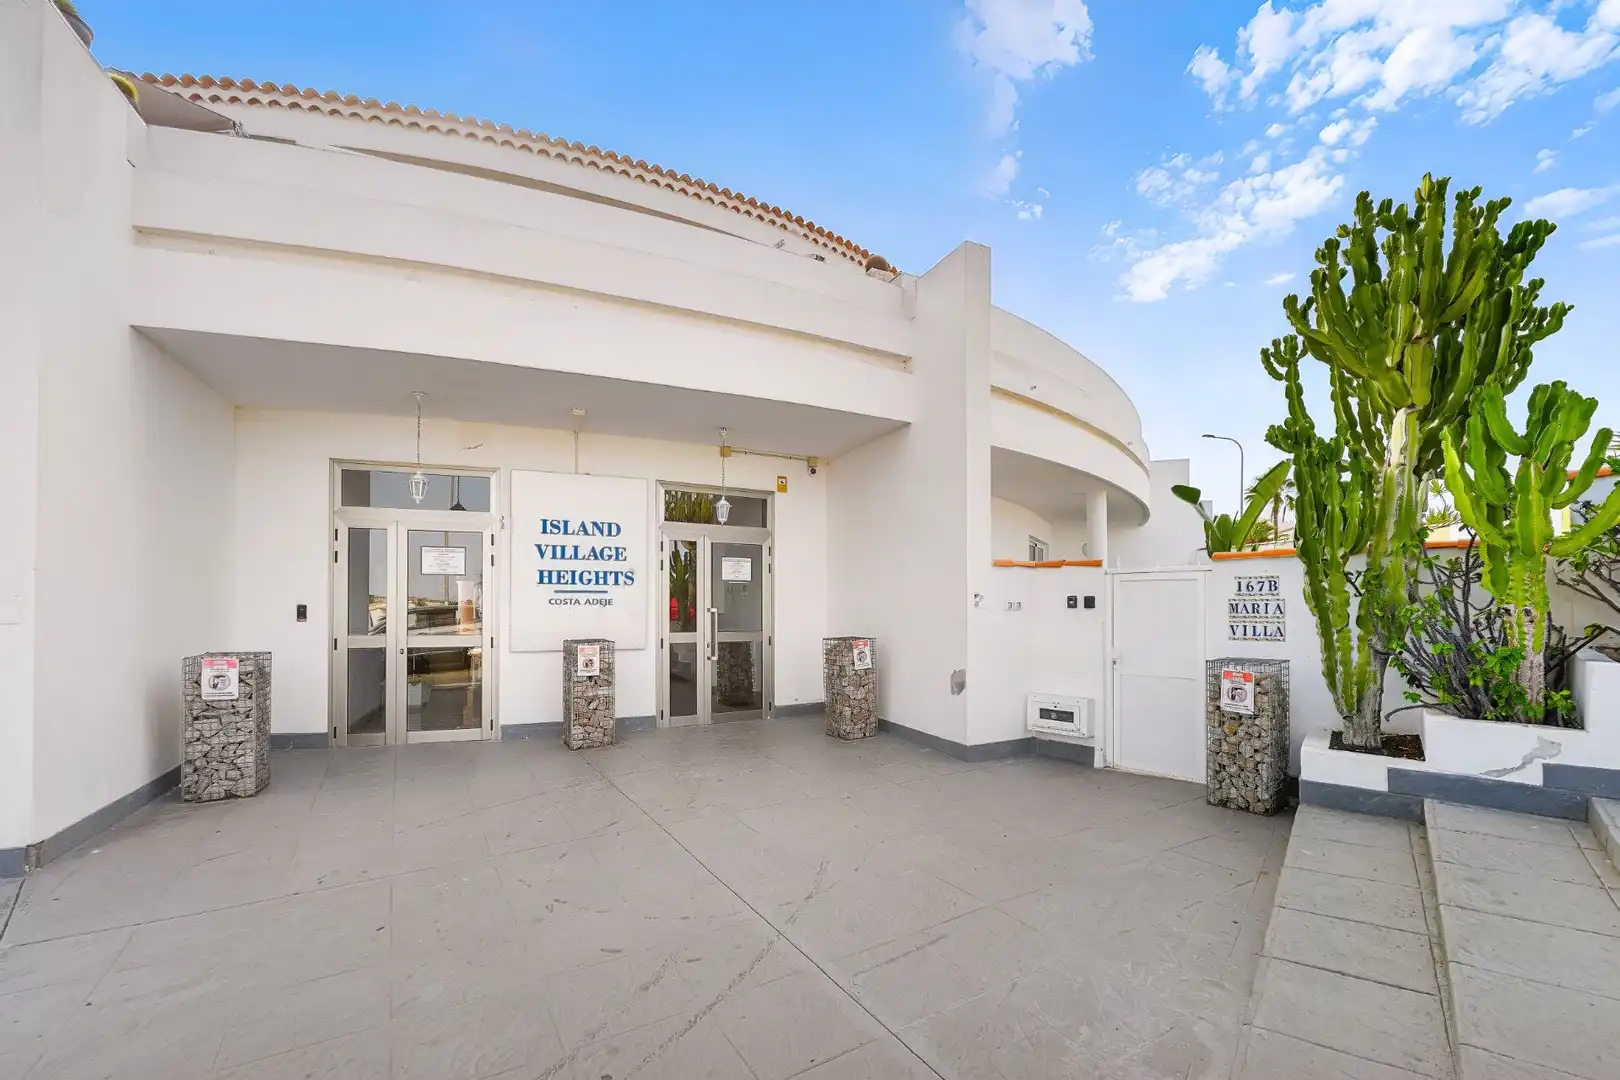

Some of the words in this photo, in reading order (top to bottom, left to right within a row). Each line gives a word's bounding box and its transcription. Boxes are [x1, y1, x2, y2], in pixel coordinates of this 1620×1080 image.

[540, 518, 622, 538] ISLAND
[534, 543, 627, 562] VILLAGE
[537, 569, 635, 586] HEIGHTS
[1236, 580, 1278, 592] 167B
[548, 598, 581, 606] COSTA
[584, 598, 614, 608] ADEJE
[1229, 602, 1284, 615] MARIA
[1229, 624, 1284, 637] VILLA
